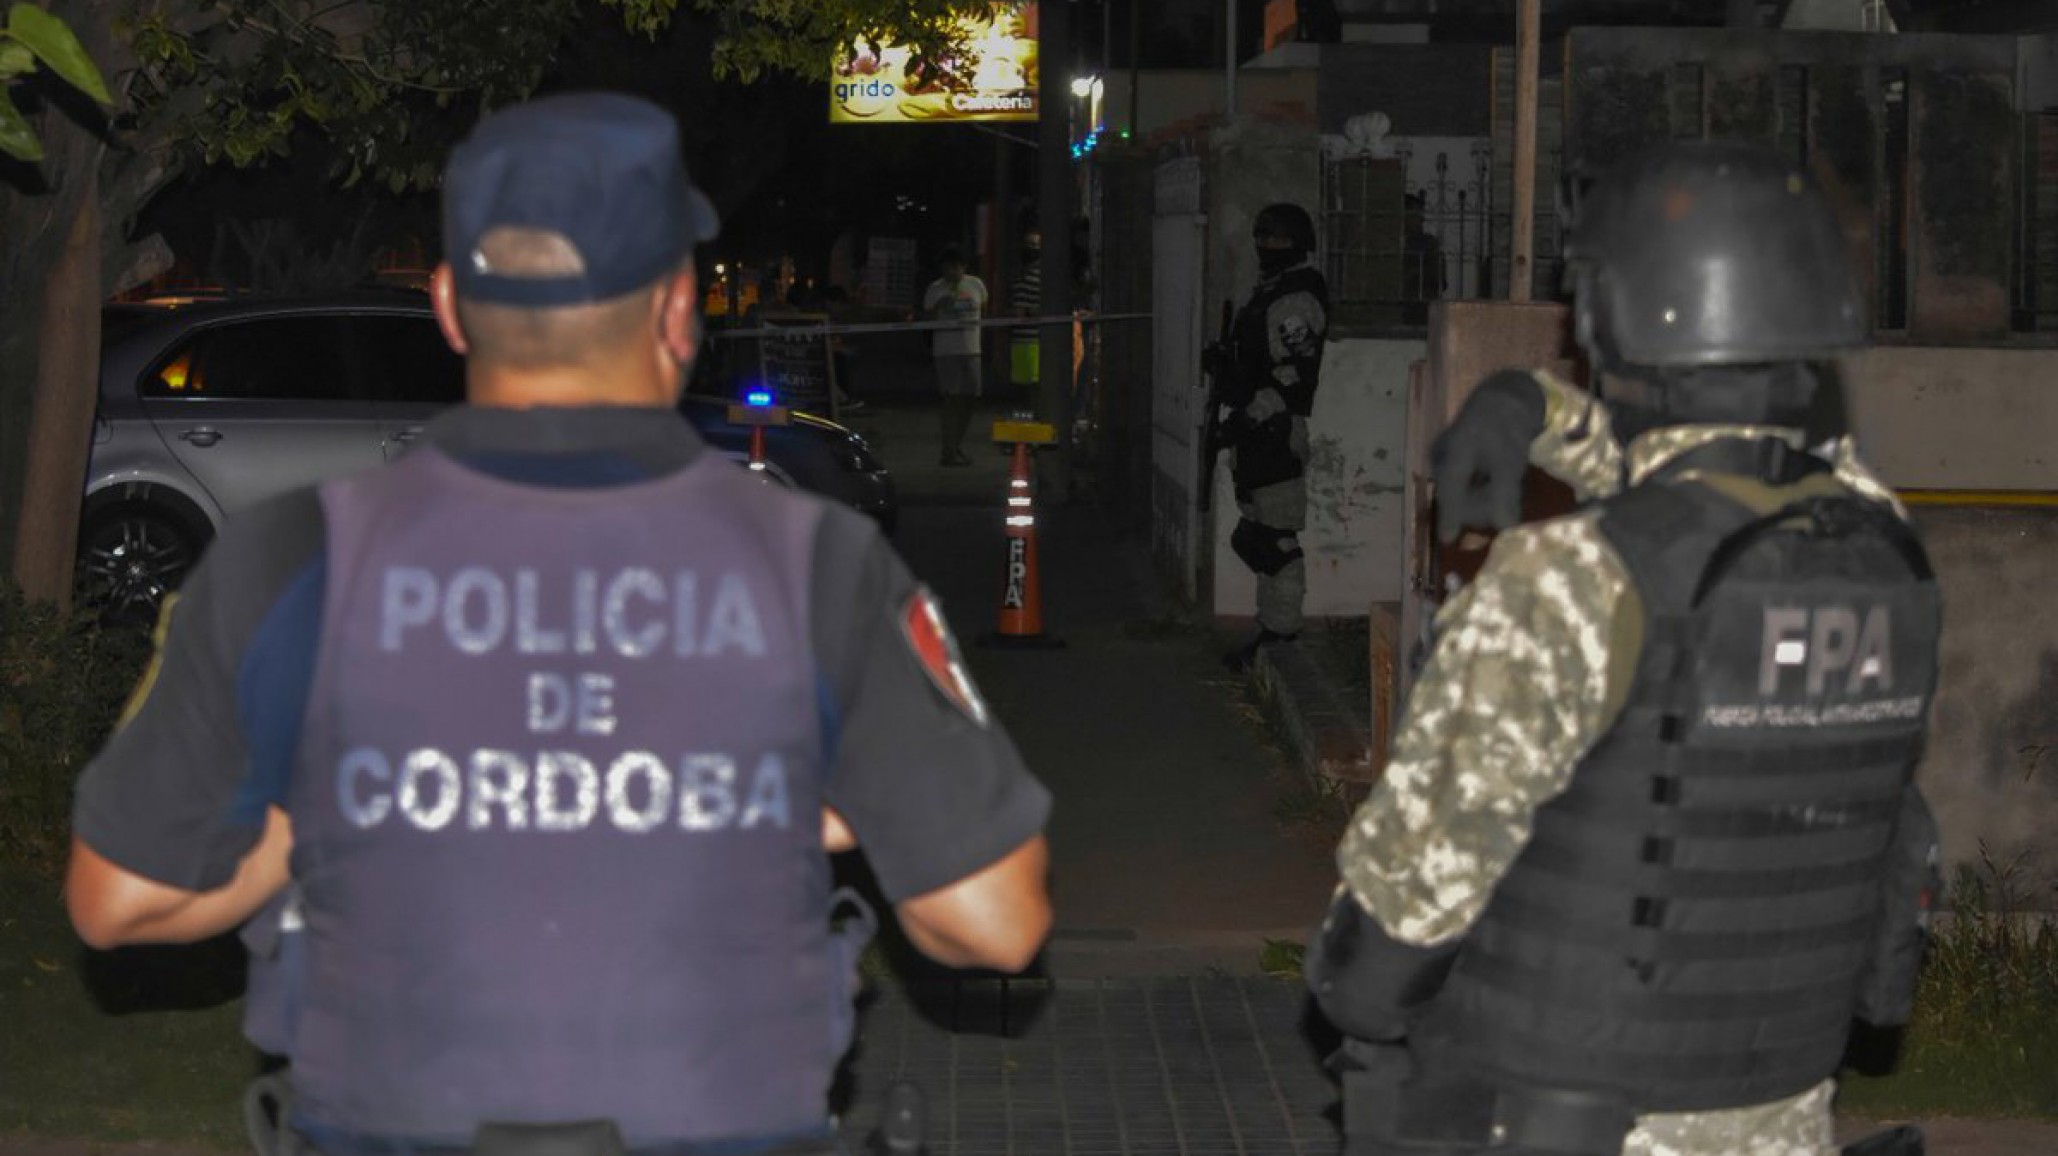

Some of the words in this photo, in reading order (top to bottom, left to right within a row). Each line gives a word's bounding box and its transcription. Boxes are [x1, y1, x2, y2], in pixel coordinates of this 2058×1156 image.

[835, 79, 895, 102] grido
[1004, 537, 1027, 607] FPA
[378, 566, 768, 657] POLICIA
[1758, 604, 1893, 696] FPA
[526, 671, 617, 735] DE
[336, 747, 792, 832] CORDOBA
